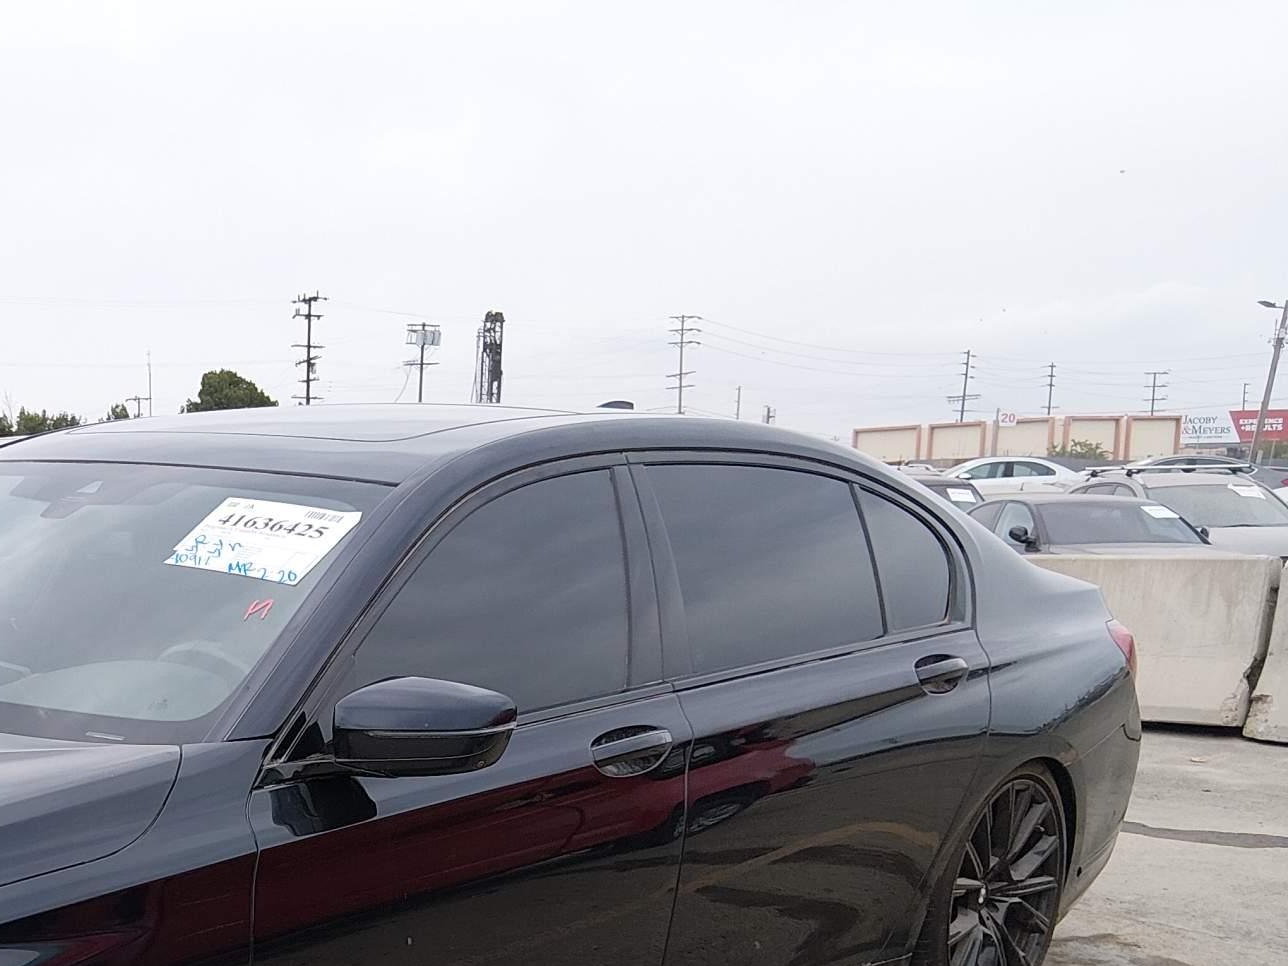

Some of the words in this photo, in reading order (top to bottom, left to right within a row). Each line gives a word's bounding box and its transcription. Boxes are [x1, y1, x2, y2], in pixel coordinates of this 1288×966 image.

[1000, 412, 1016, 424] 20
[1183, 415, 1218, 425] JACOBY
[218, 513, 329, 539] 41636425
